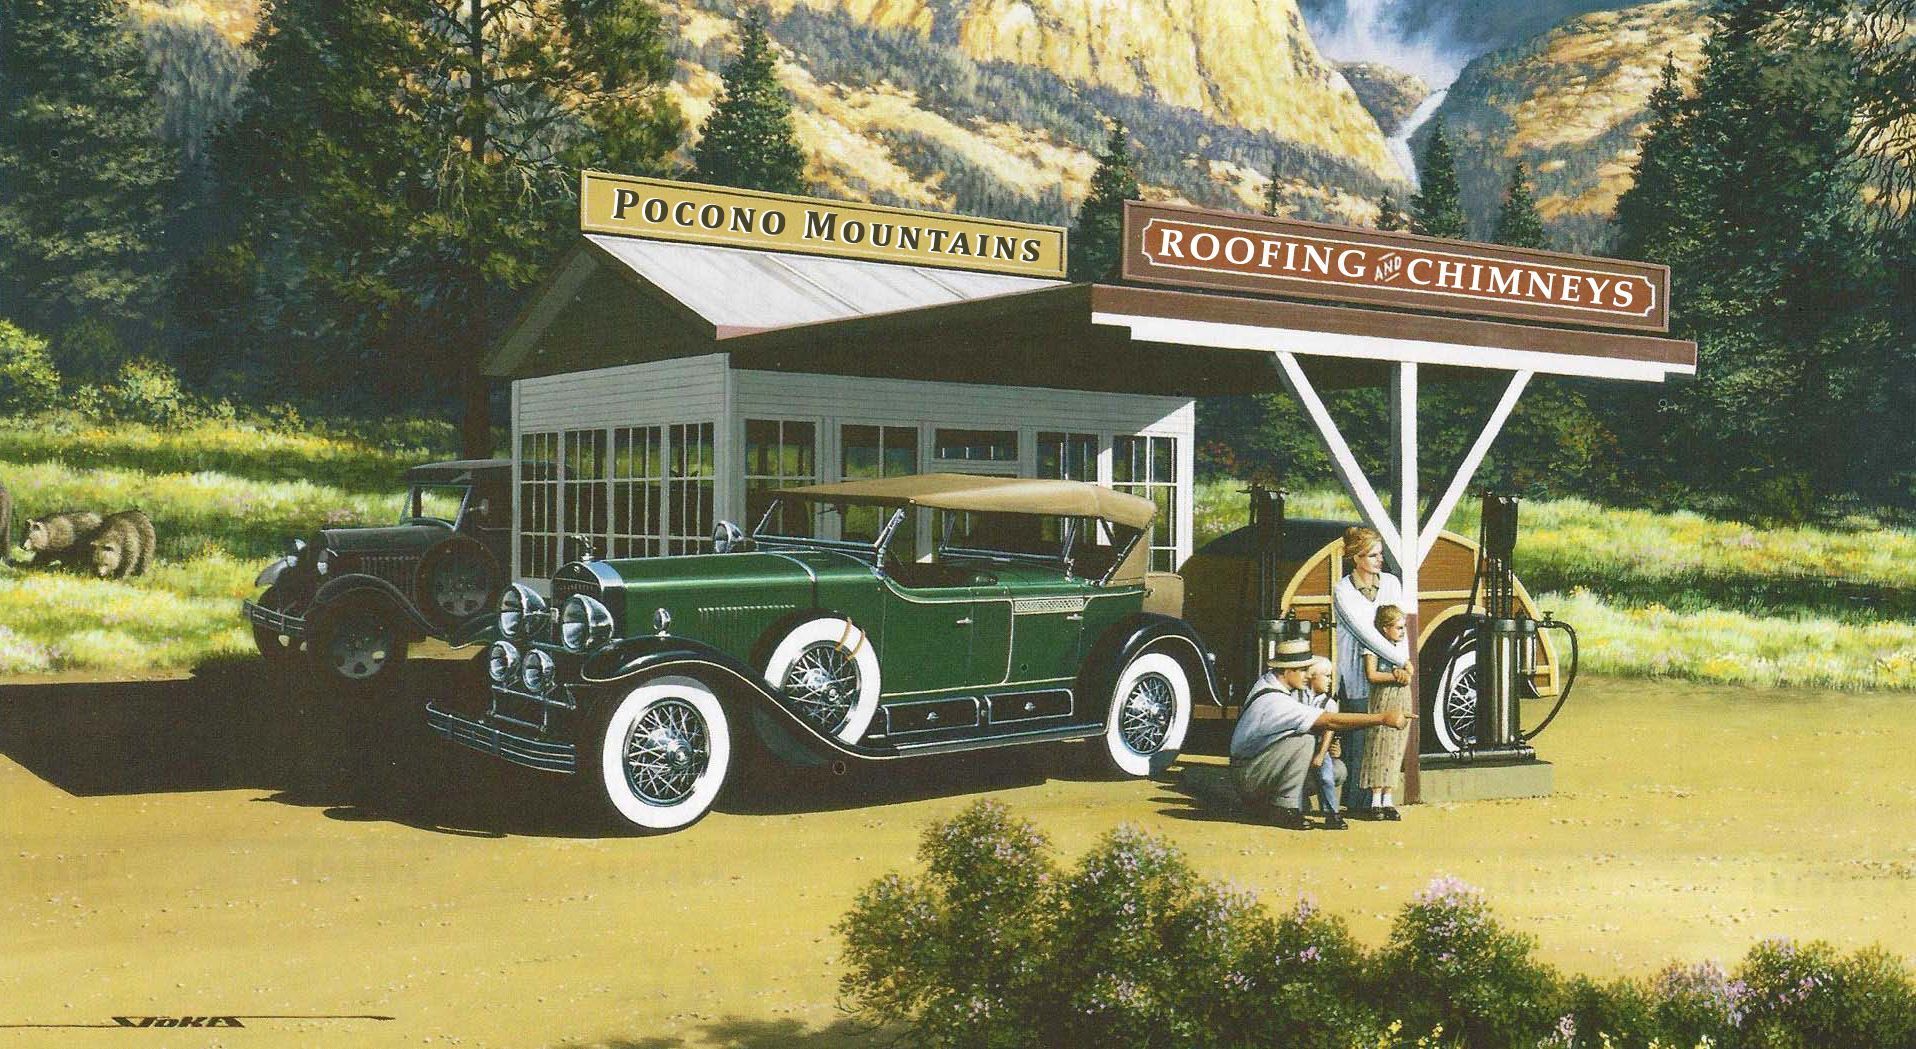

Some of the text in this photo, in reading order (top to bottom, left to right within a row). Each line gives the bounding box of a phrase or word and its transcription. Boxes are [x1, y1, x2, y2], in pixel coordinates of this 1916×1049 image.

[611, 188, 1042, 263] POCONO MOUNTAINS
[1158, 228, 1634, 308] ROOFING AND CHIMNEYS
